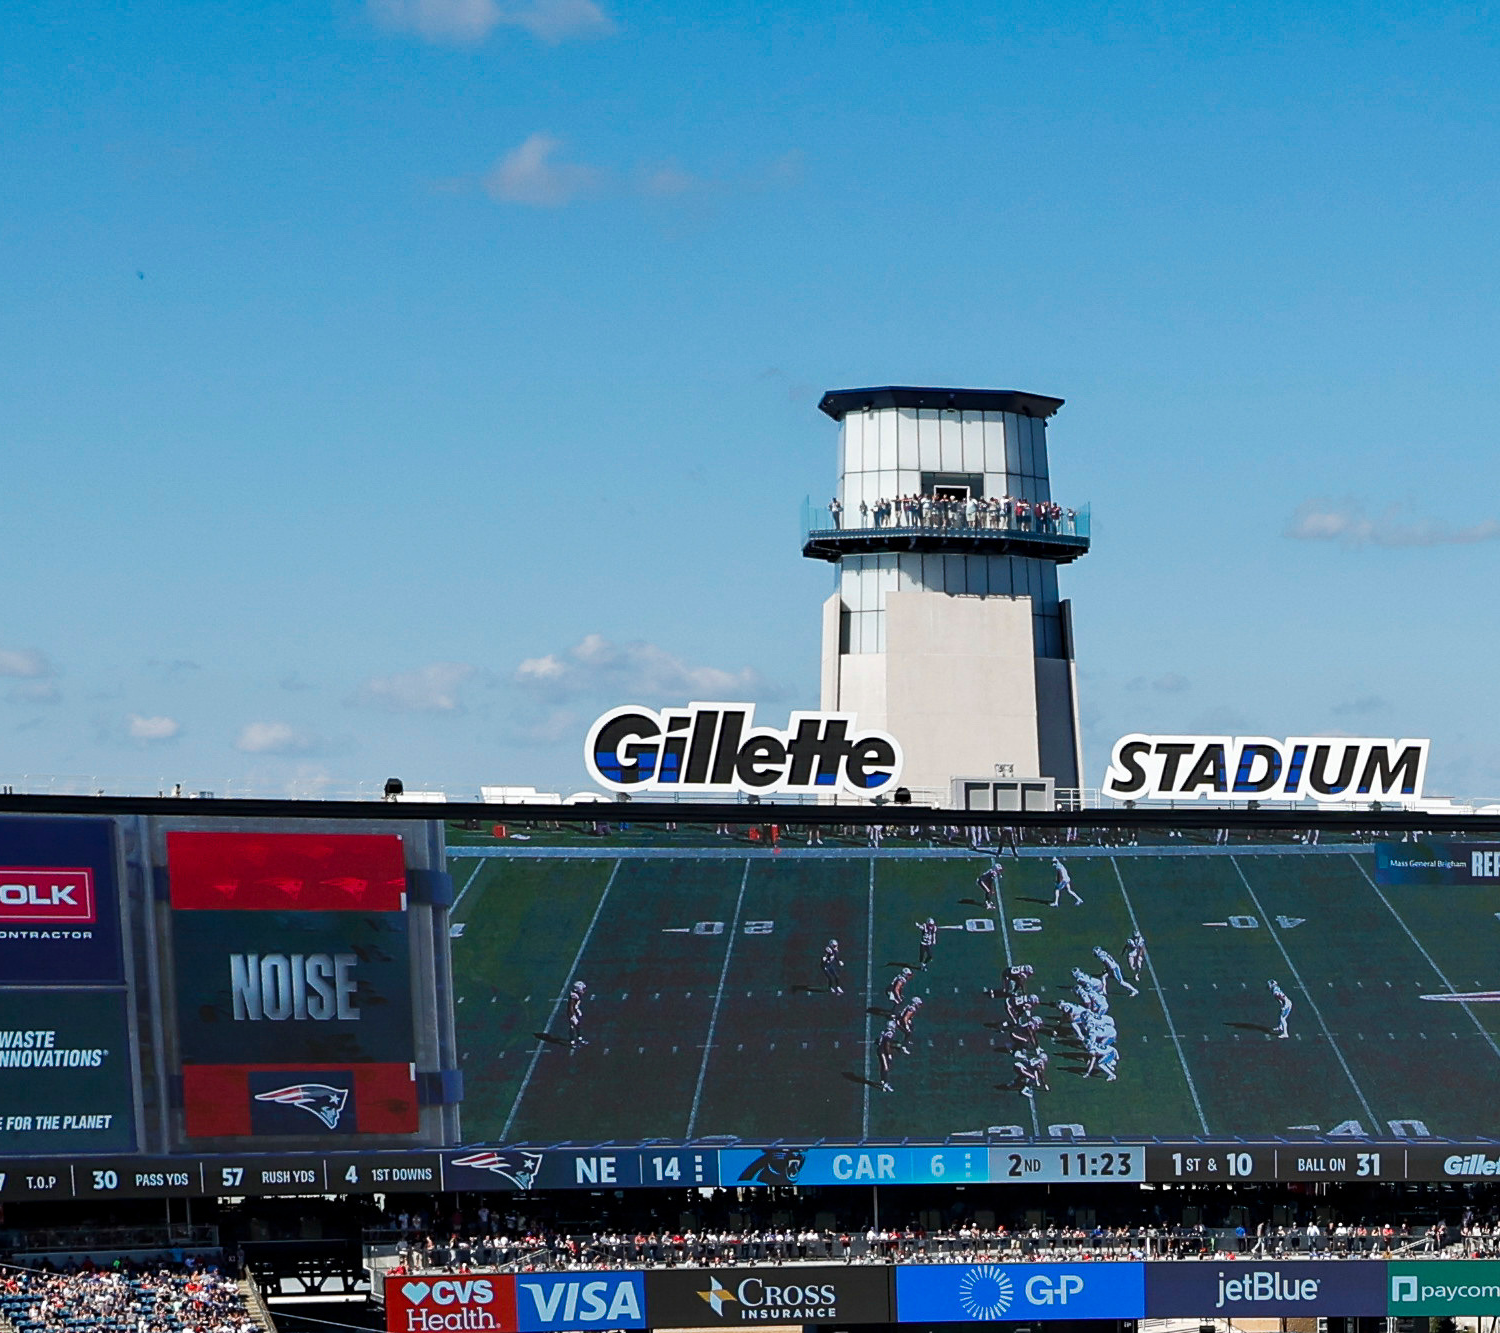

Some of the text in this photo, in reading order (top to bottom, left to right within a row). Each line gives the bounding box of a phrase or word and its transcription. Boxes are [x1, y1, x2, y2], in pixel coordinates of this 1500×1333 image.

[591, 705, 1425, 796] Gillette STADIUM
[229, 953, 361, 1021] NOISE
[6, 1116, 31, 1131] FOR
[35, 1115, 60, 1130] THE
[63, 1115, 112, 1130] PLANET
[575, 1153, 1132, 1184] NE 14 CAR 6 2ND 11:23
[1208, 1158, 1217, 1172] &
[1226, 1152, 1253, 1177] 10
[1297, 1157, 1326, 1172] BALL
[1329, 1157, 1346, 1172] ON
[1356, 1153, 1380, 1177] 31
[26, 1176, 56, 1189] T.O.P
[92, 1170, 118, 1190] 30
[135, 1173, 164, 1187] PASS
[166, 1172, 189, 1186] YDS
[221, 1167, 244, 1187] 57
[261, 1170, 290, 1184] RUSH
[293, 1169, 315, 1183] YDS
[344, 1165, 358, 1183] 4
[371, 1168, 390, 1182] 1ST
[392, 1167, 432, 1181] DOWNS
[432, 1279, 493, 1303] CVS
[520, 1280, 642, 1322] VISA
[1216, 1271, 1318, 1307] jetBlue
[1421, 1284, 1500, 1300] paycom
[406, 1306, 497, 1332] Health
[741, 1307, 837, 1320] INSURANCE
